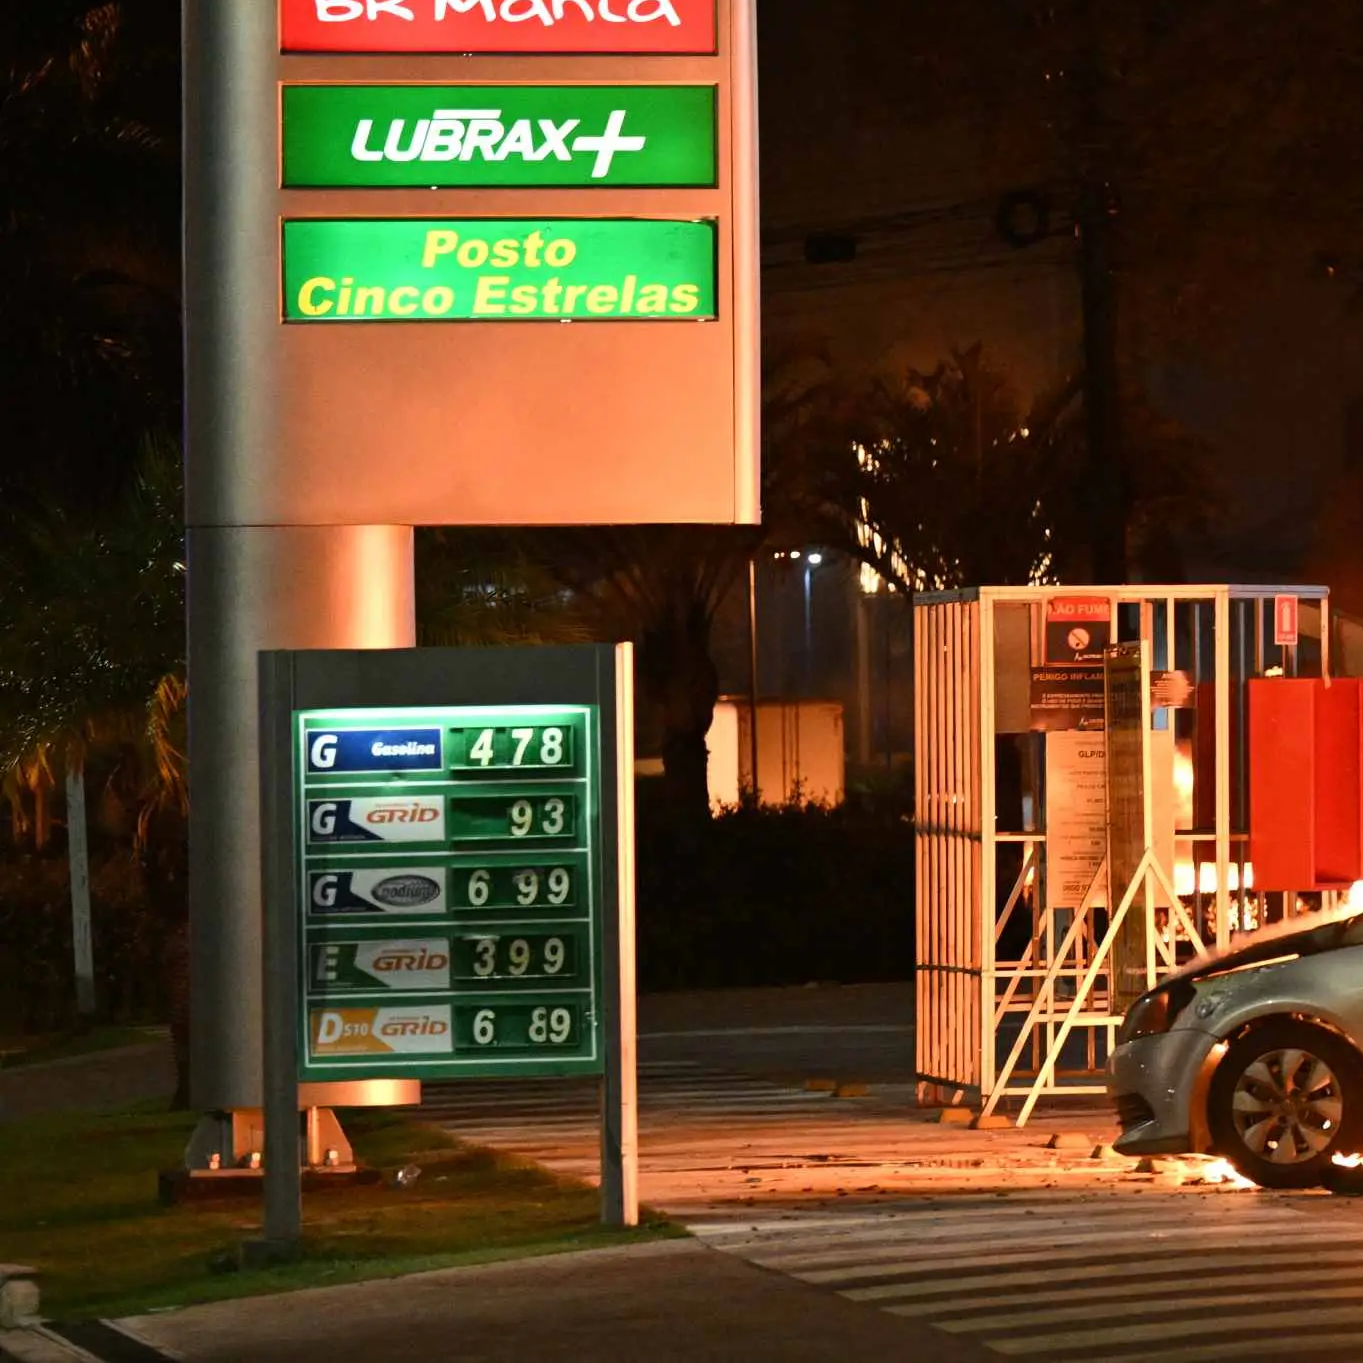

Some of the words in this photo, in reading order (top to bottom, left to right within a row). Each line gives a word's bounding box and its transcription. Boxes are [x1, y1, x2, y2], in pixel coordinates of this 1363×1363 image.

[422, 229, 577, 268] Posto
[298, 277, 455, 315] Cinco
[472, 274, 700, 316] Estrelas
[311, 734, 338, 768] G
[371, 740, 436, 757] Gasolina
[312, 803, 337, 834] G
[313, 875, 338, 906] G
